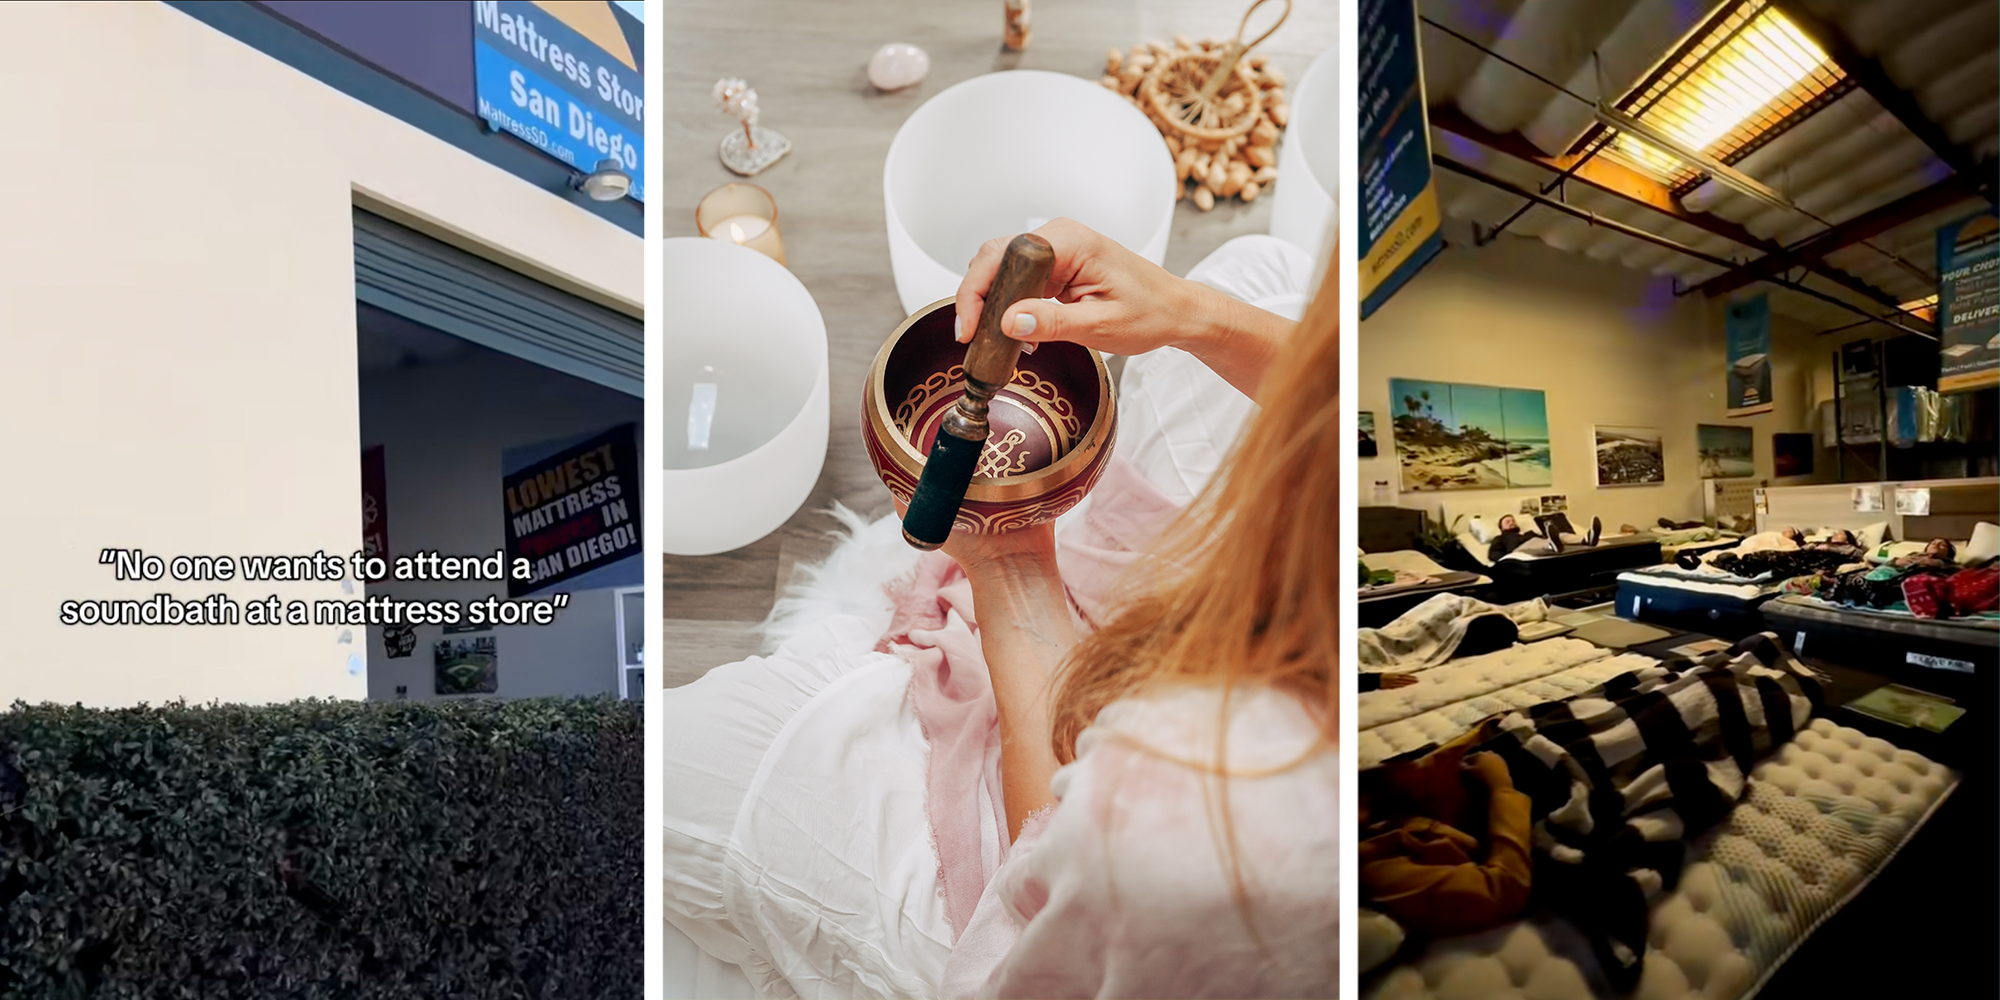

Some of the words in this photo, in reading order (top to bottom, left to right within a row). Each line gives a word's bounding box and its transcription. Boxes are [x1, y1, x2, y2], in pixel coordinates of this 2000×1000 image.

[477, 0, 591, 89] Mattress
[597, 65, 643, 121] Stor
[510, 69, 560, 129] San
[568, 101, 637, 171] Diego
[1942, 267, 1970, 283] YOUR
[506, 443, 615, 515] LOWEST
[512, 475, 622, 538] MATTRESS
[601, 498, 629, 527] IN
[526, 551, 565, 585] SAN
[565, 522, 637, 569] DIEGO!
